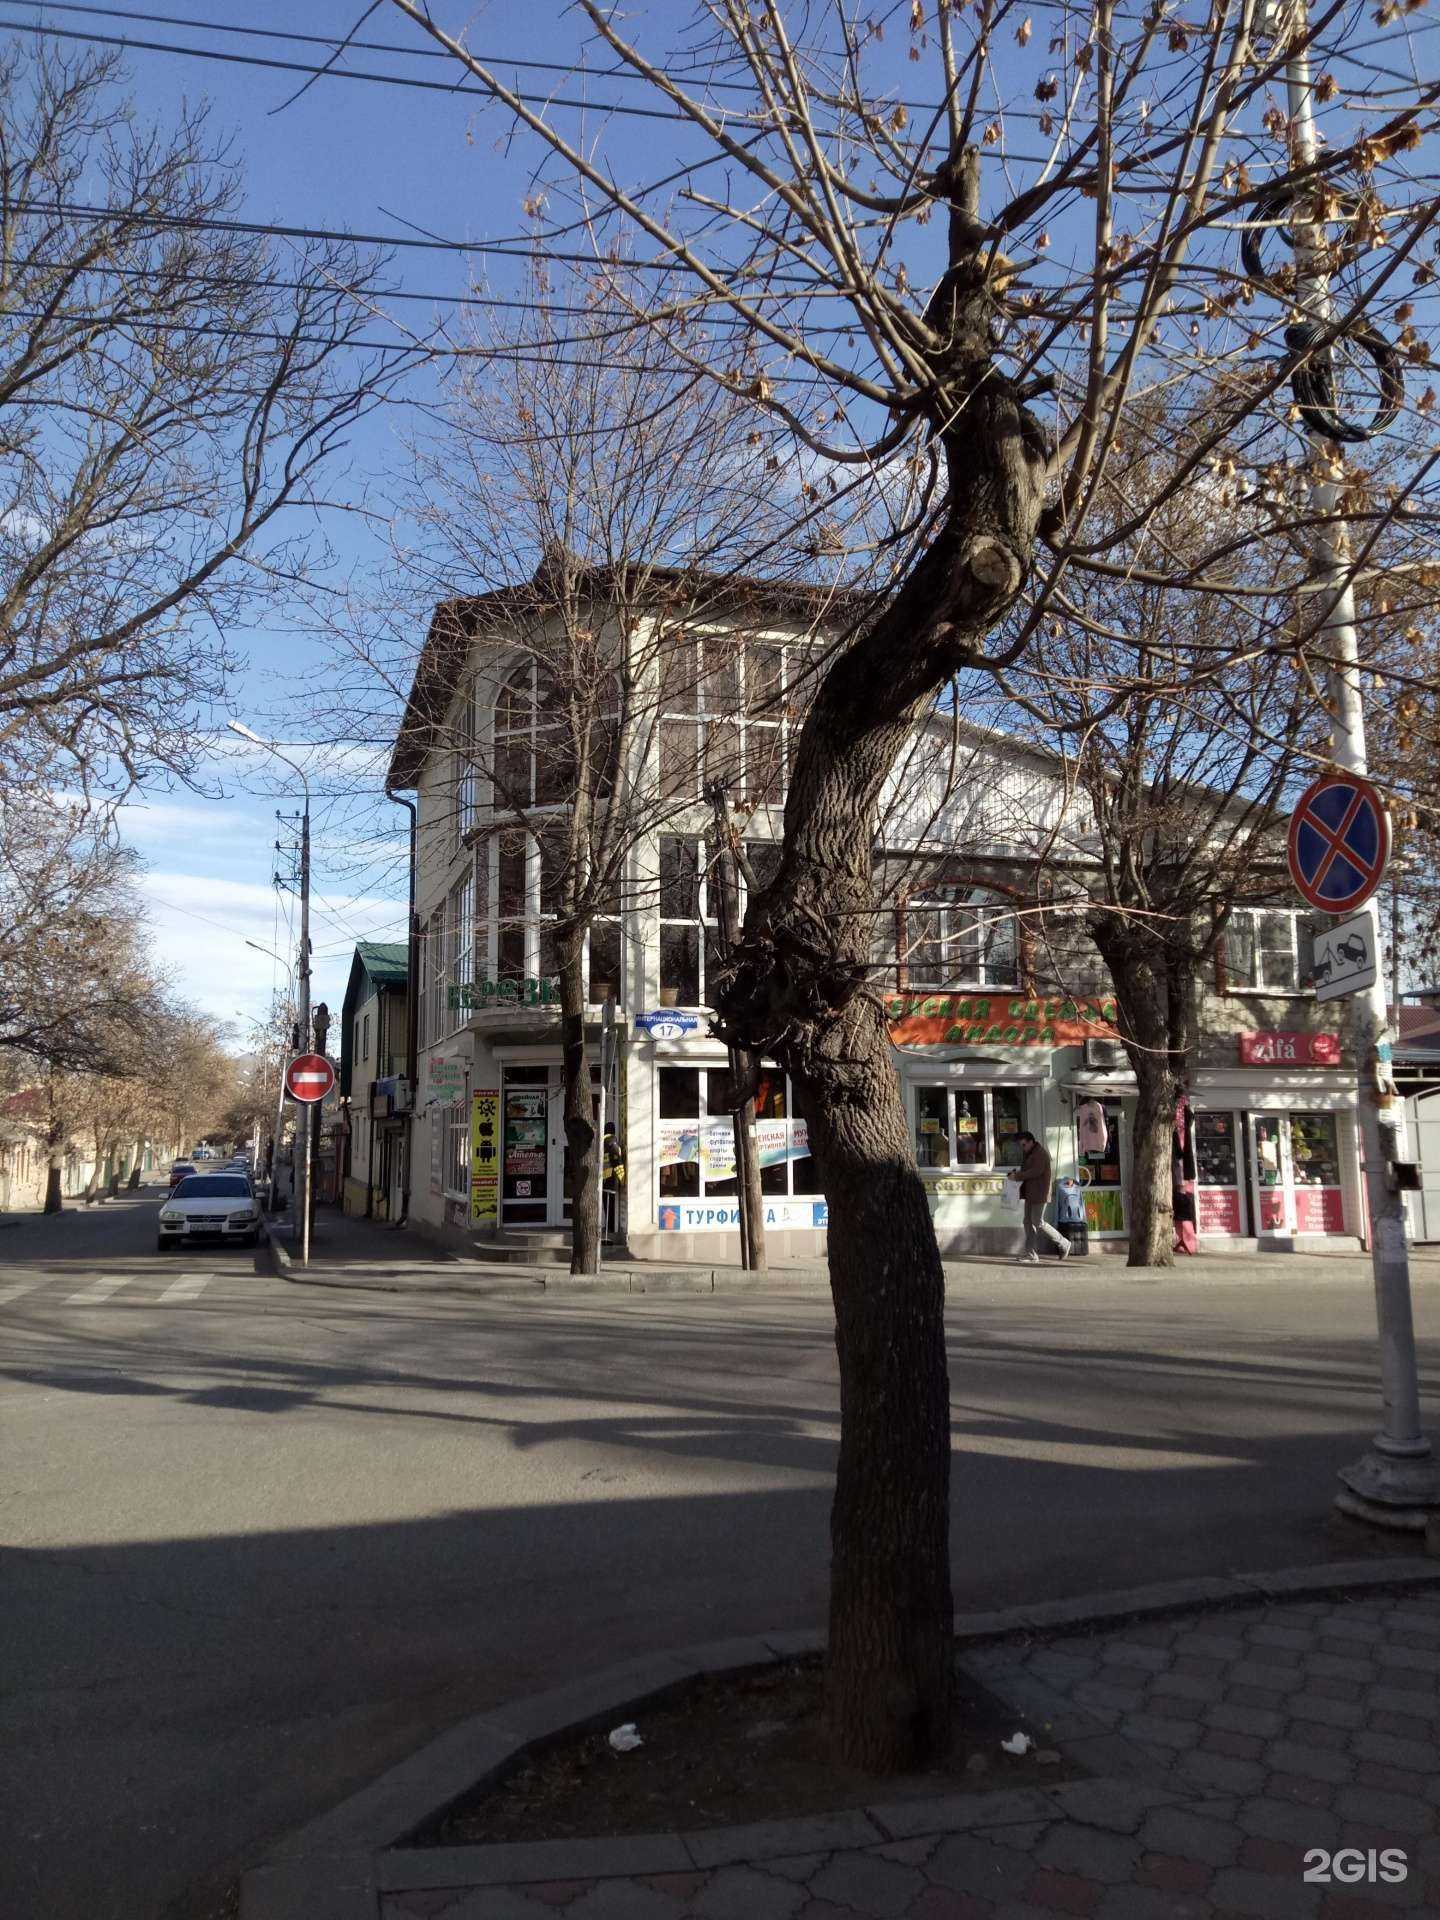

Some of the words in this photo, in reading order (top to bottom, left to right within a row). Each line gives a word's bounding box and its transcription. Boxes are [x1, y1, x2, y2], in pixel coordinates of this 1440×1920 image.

[890, 999, 990, 1021] ЕНСКАЯ
[636, 1015, 698, 1023] ИНТЕРНАЦИОНАЛЬНАЯ
[660, 1025, 674, 1036] 17
[757, 1131, 784, 1143] ЕНСКАЯ
[686, 1206, 776, 1225] ТУРФИА
